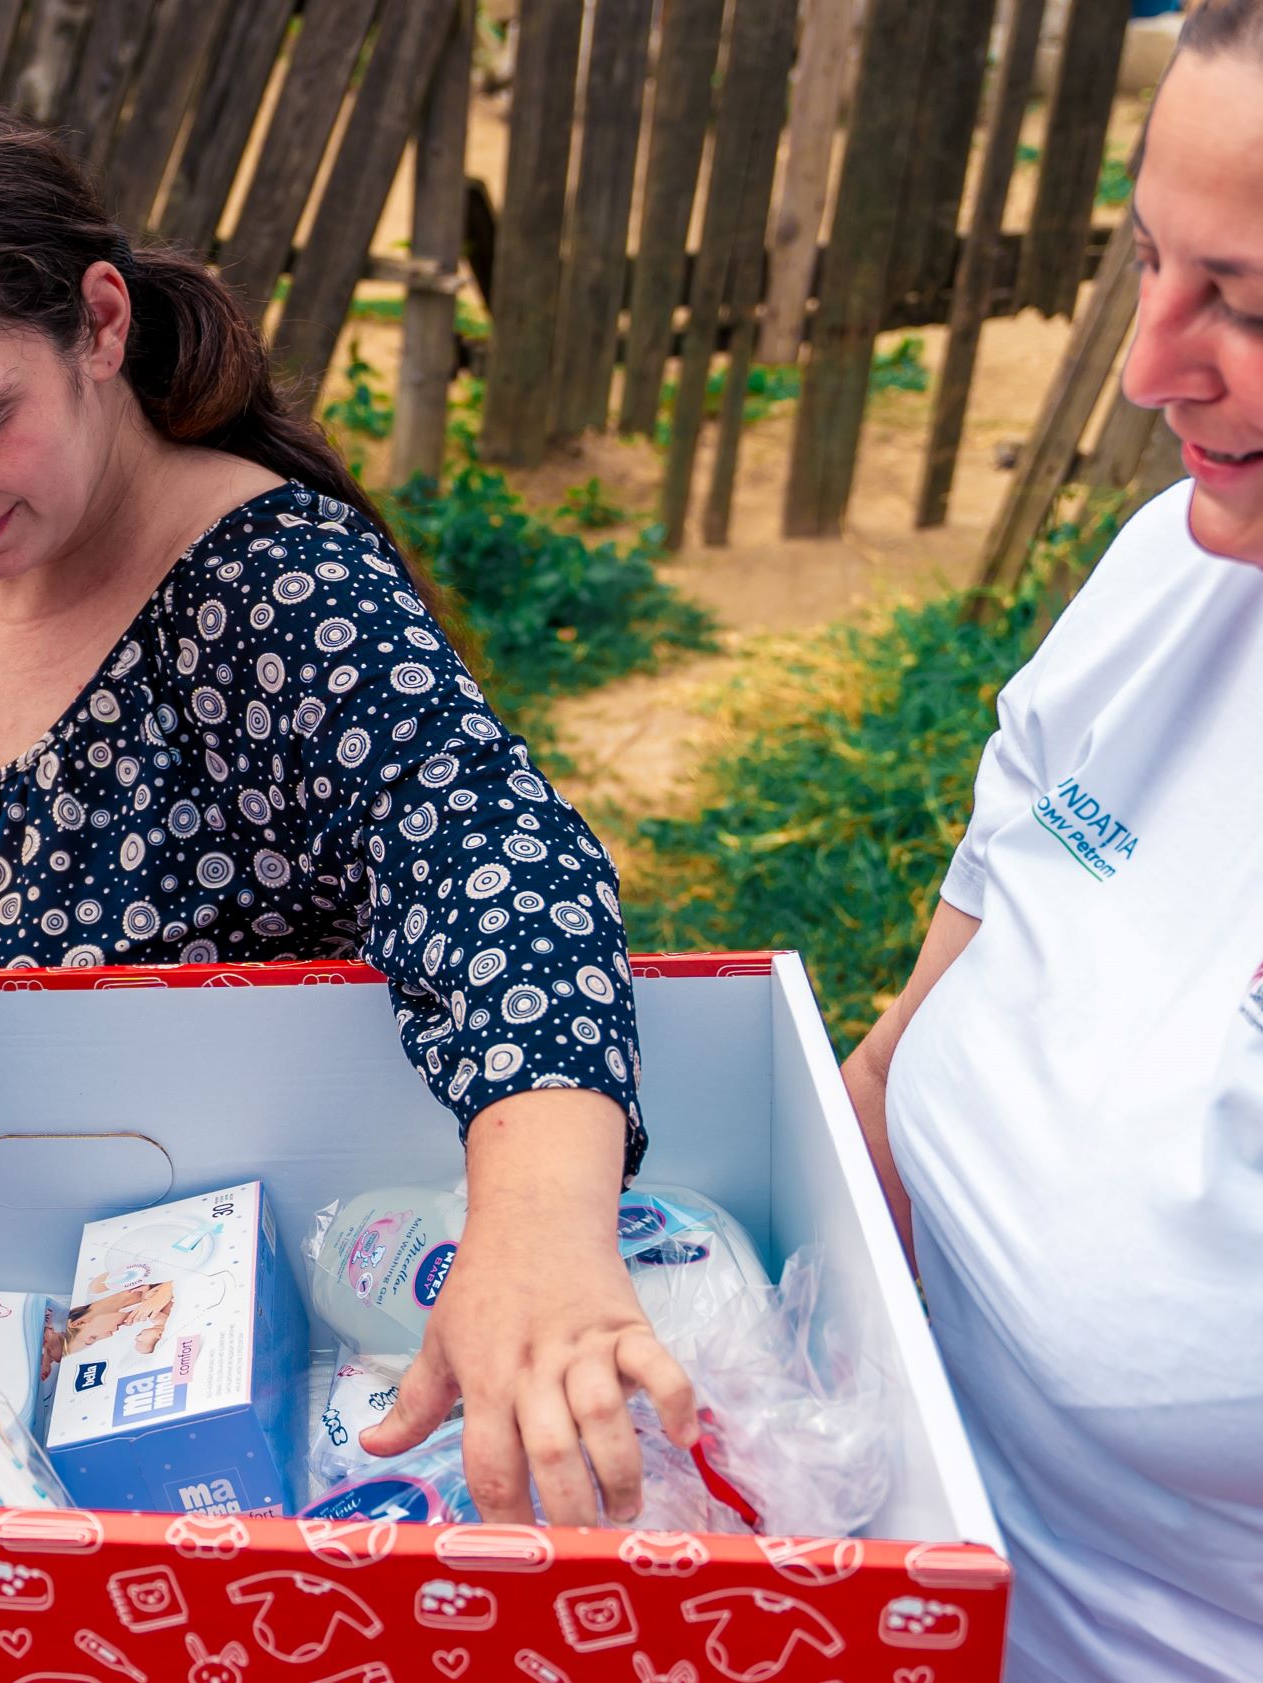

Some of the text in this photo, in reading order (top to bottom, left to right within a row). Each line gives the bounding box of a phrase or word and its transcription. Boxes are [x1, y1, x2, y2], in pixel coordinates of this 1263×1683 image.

[1036, 796, 1117, 878] OMV Petrom
[212, 1202, 234, 1219] 30
[375, 1216, 422, 1306] Mild Washing Gel
[392, 1232, 427, 1296] Micellar
[423, 1255, 442, 1291] BABY
[425, 1250, 456, 1301] NIVEA
[81, 1365, 97, 1388] bella
[179, 1338, 193, 1376] comfort
[122, 1376, 155, 1417] ma
[178, 1478, 236, 1510] ma
